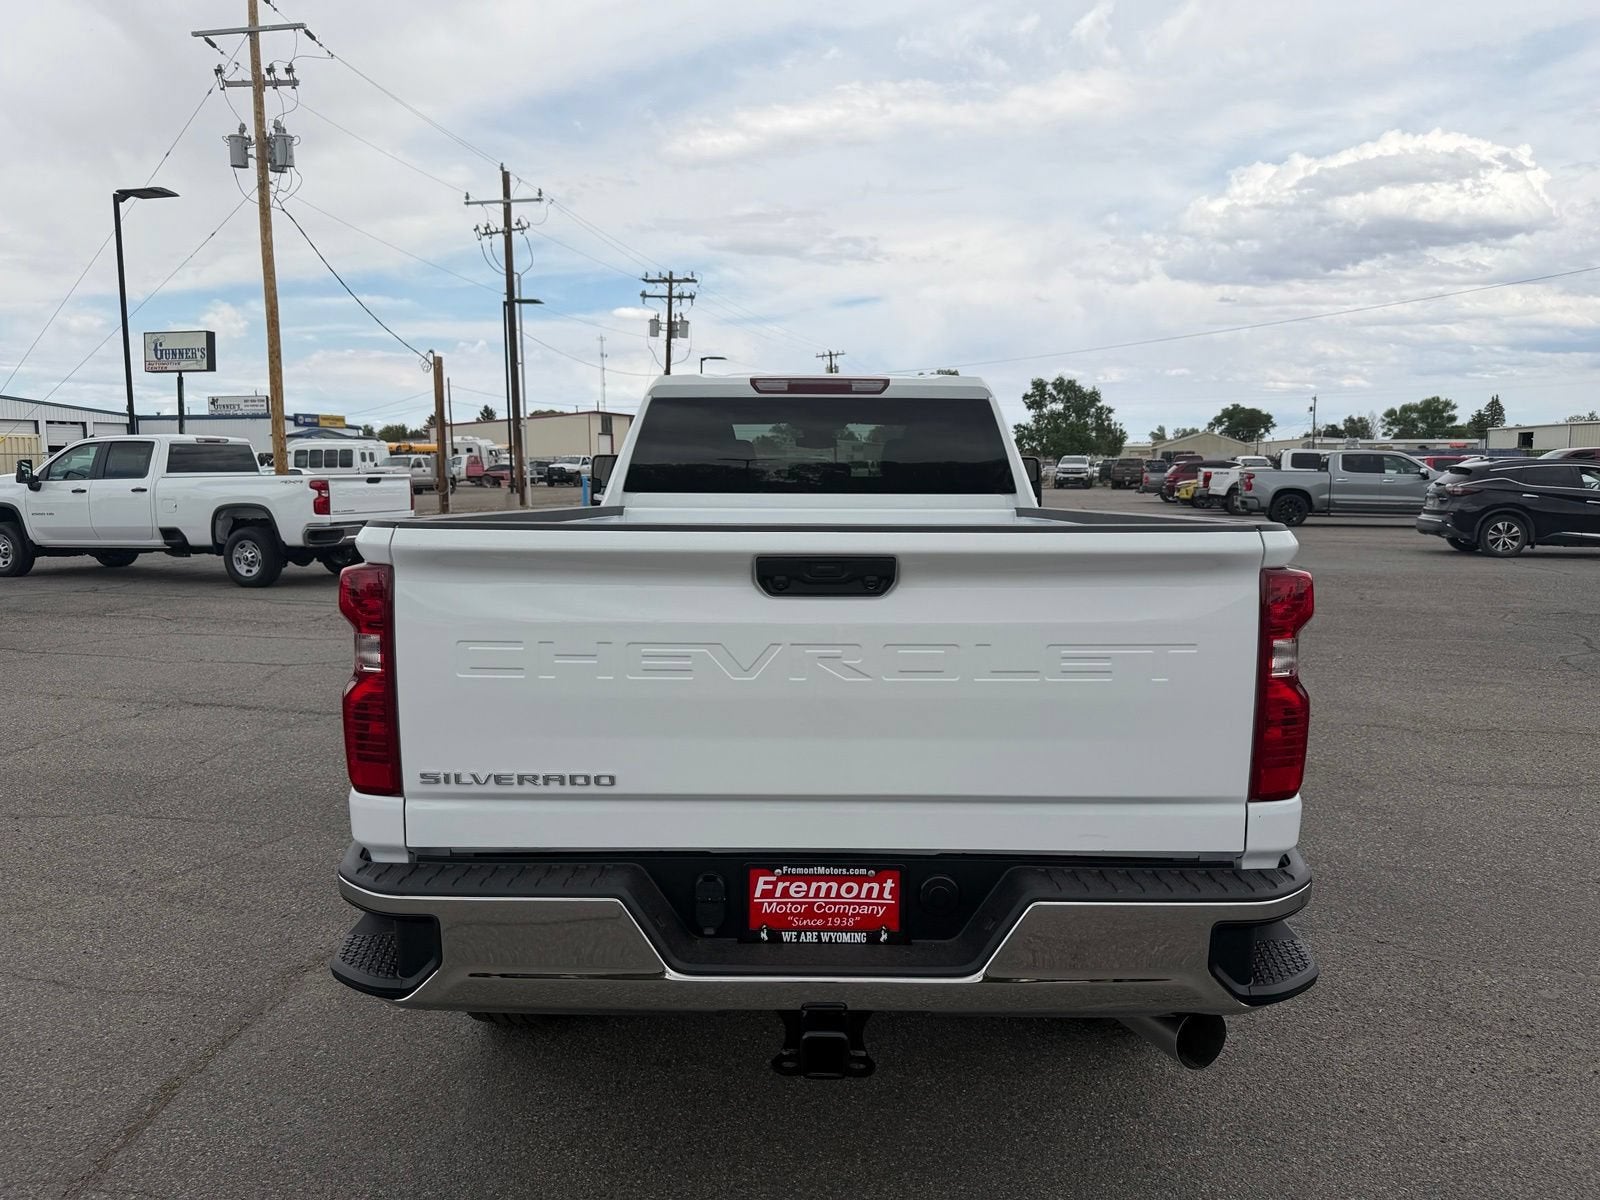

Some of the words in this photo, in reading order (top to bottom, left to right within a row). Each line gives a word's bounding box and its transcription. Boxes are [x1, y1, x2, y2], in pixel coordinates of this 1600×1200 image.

[153, 342, 206, 360] GUNNER'S
[456, 640, 1198, 682] CHEVROLET
[419, 772, 616, 786] SILVERADO
[782, 866, 867, 876] FremontMotors.com
[754, 876, 895, 899] Fremont
[762, 902, 808, 914] Motor
[813, 902, 886, 917] Company
[782, 932, 797, 943] WE
[799, 932, 818, 943] ARE
[820, 932, 867, 943] WYOMING
